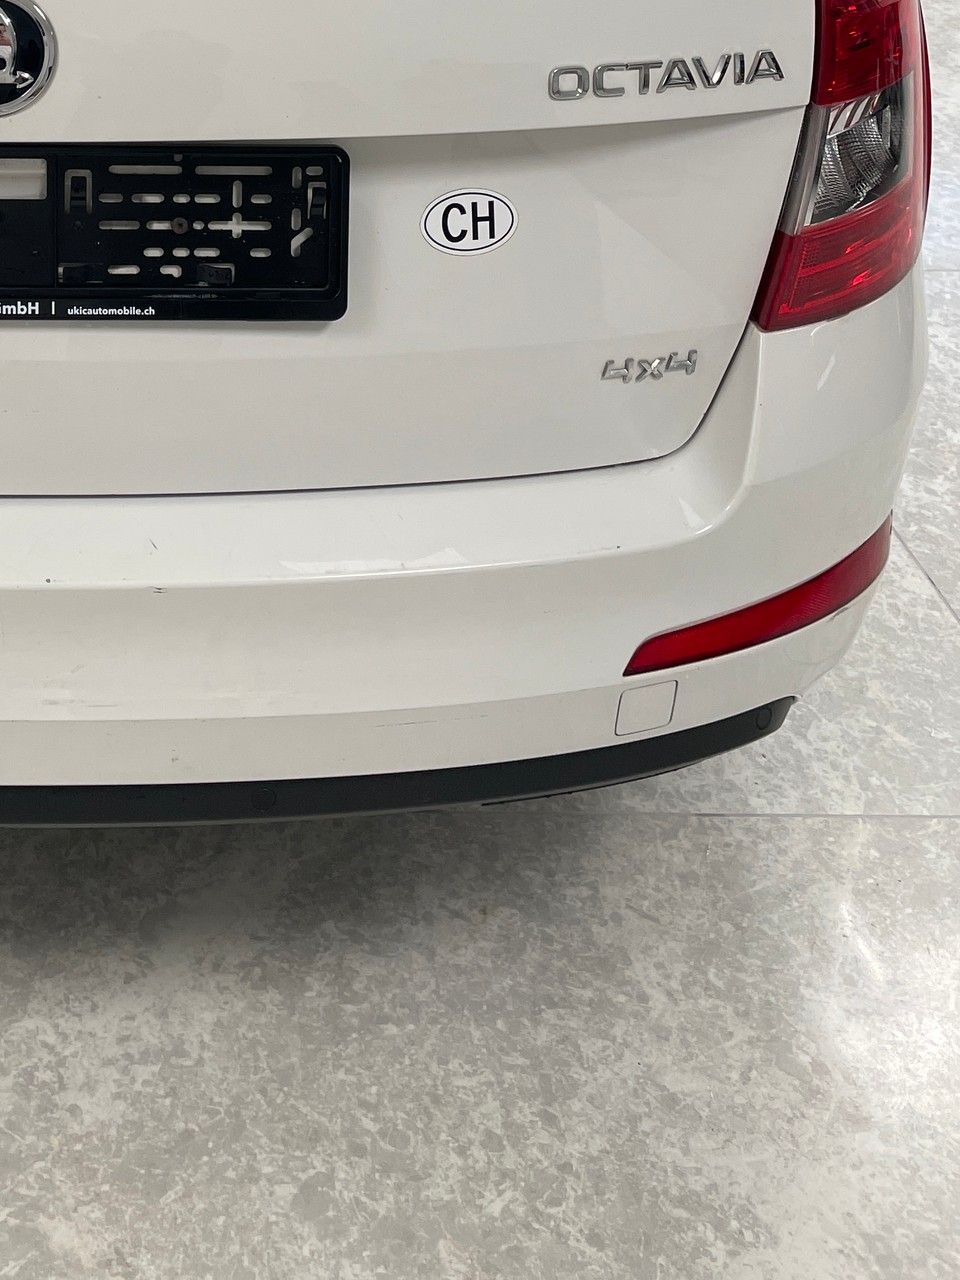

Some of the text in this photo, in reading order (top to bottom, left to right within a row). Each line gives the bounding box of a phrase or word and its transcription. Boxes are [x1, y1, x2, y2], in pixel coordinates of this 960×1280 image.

[548, 49, 785, 101] OCTAVIA
[442, 200, 496, 243] CH
[67, 306, 156, 316] ukicautomobile.ch
